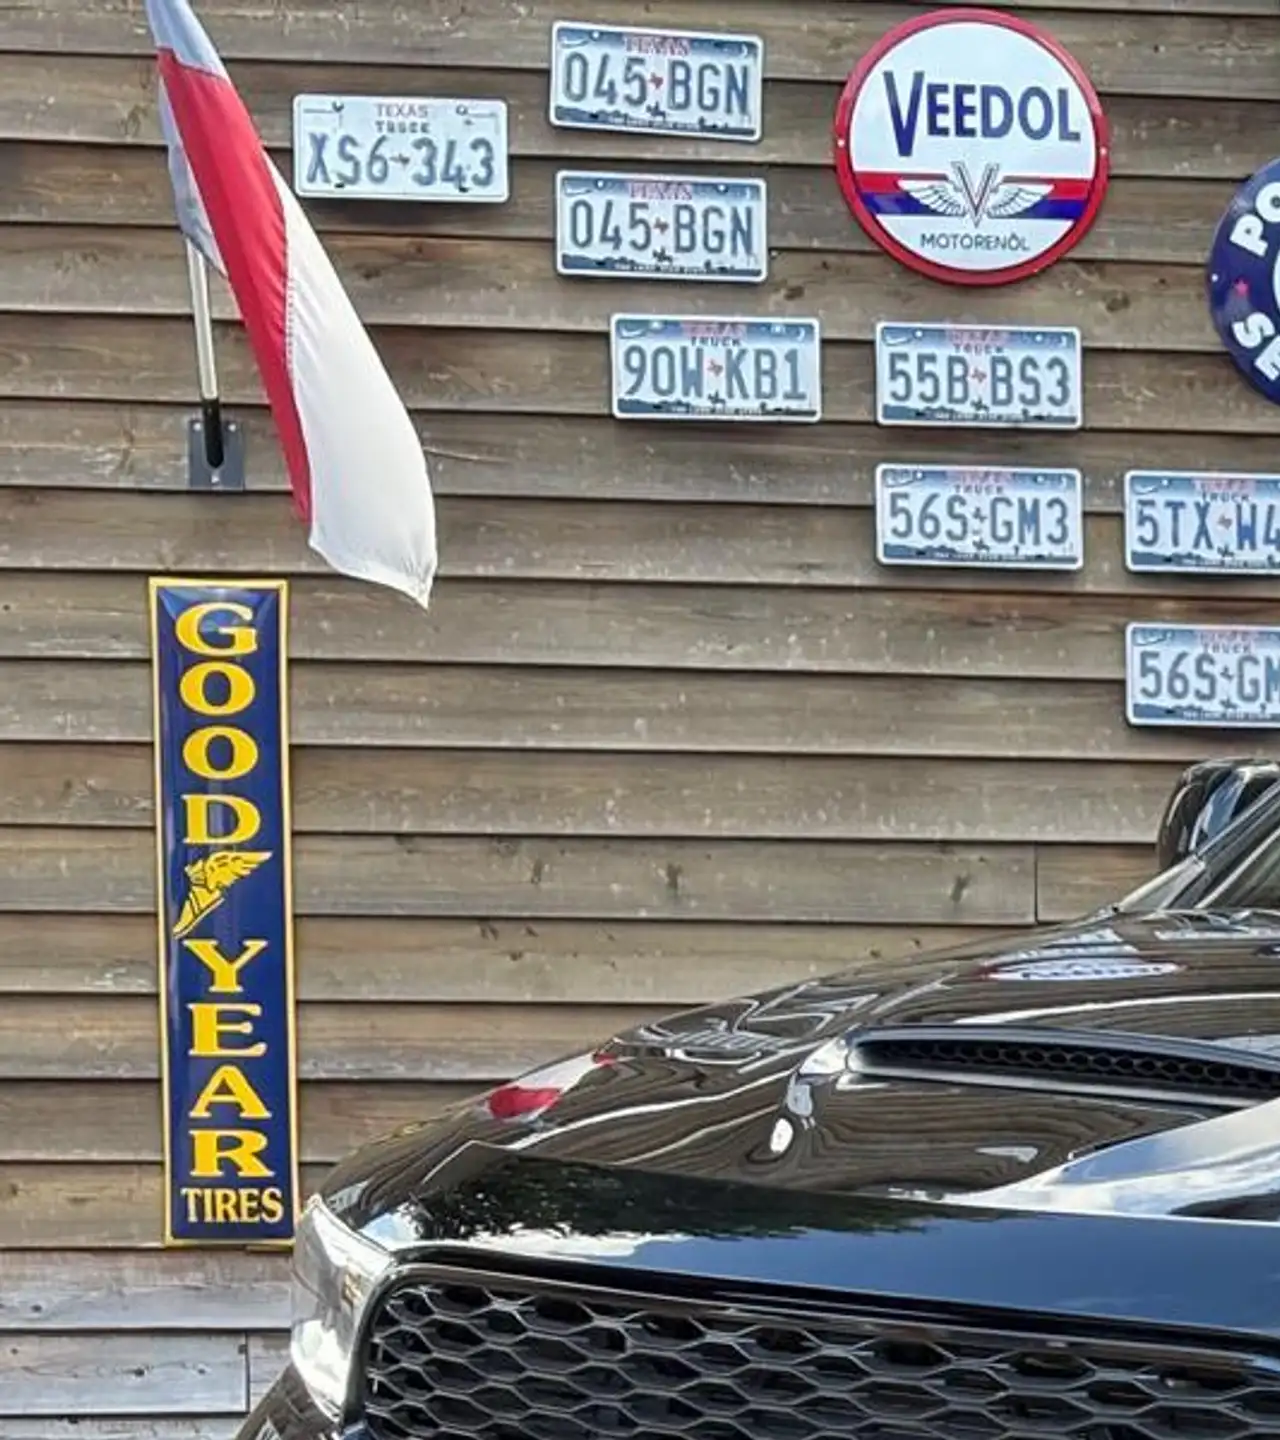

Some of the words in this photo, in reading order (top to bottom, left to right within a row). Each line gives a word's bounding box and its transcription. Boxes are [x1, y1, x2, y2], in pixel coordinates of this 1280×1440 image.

[375, 103, 428, 118] TEXAS
[667, 60, 748, 115] BGN
[883, 70, 1080, 157] VEEDOL
[411, 137, 494, 187] 343
[674, 205, 753, 256] BGN
[920, 232, 1030, 252] MOTORENÖL
[180, 1187, 284, 1222] TIRES
